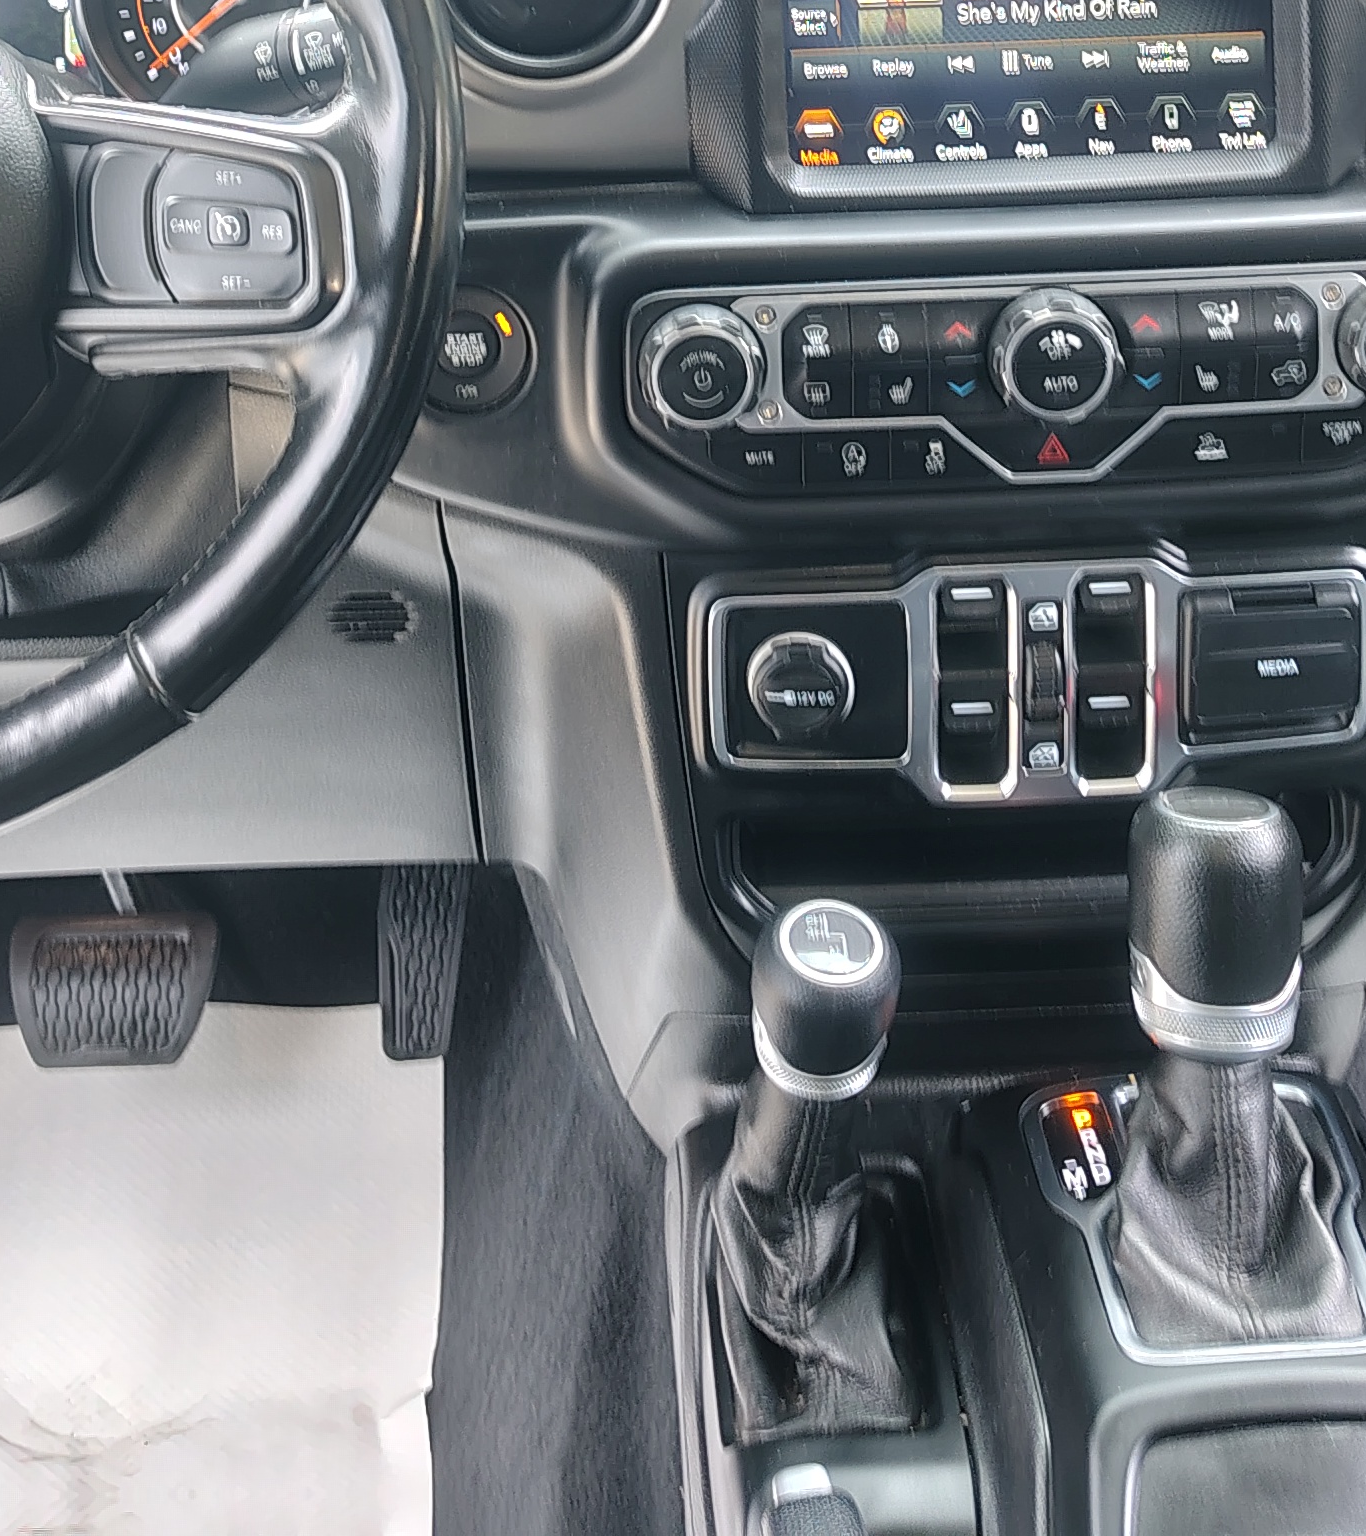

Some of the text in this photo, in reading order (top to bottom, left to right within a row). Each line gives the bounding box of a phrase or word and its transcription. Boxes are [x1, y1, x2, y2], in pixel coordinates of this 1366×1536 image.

[791, 7, 827, 21] Source
[957, 1, 1007, 25] She's
[1010, 0, 1041, 25] My
[151, 16, 167, 35] 10
[794, 21, 826, 36] Select
[1137, 41, 1175, 58] Traffic
[1211, 45, 1250, 64] Audio
[804, 61, 849, 79] Browse
[872, 58, 915, 78] Replay
[1022, 53, 1054, 71] Tune
[1137, 56, 1191, 74] Weather
[935, 142, 987, 162] Controls
[1014, 140, 1049, 160] Apps
[1088, 137, 1115, 156] Nav
[1151, 135, 1193, 154] Phone
[800, 147, 839, 166] Media
[866, 146, 915, 164] Climate
[261, 224, 284, 241] RES
[446, 332, 484, 345] START
[1208, 326, 1234, 341] MODE
[802, 344, 832, 359] FRONT
[1046, 344, 1072, 362] OFF
[1043, 375, 1078, 393] AUTO
[745, 449, 774, 466] MUTE
[1256, 657, 1300, 678] MEDIA
[1071, 1108, 1093, 1129] P
[1062, 1166, 1088, 1191] M
[1090, 1163, 1112, 1186] D
